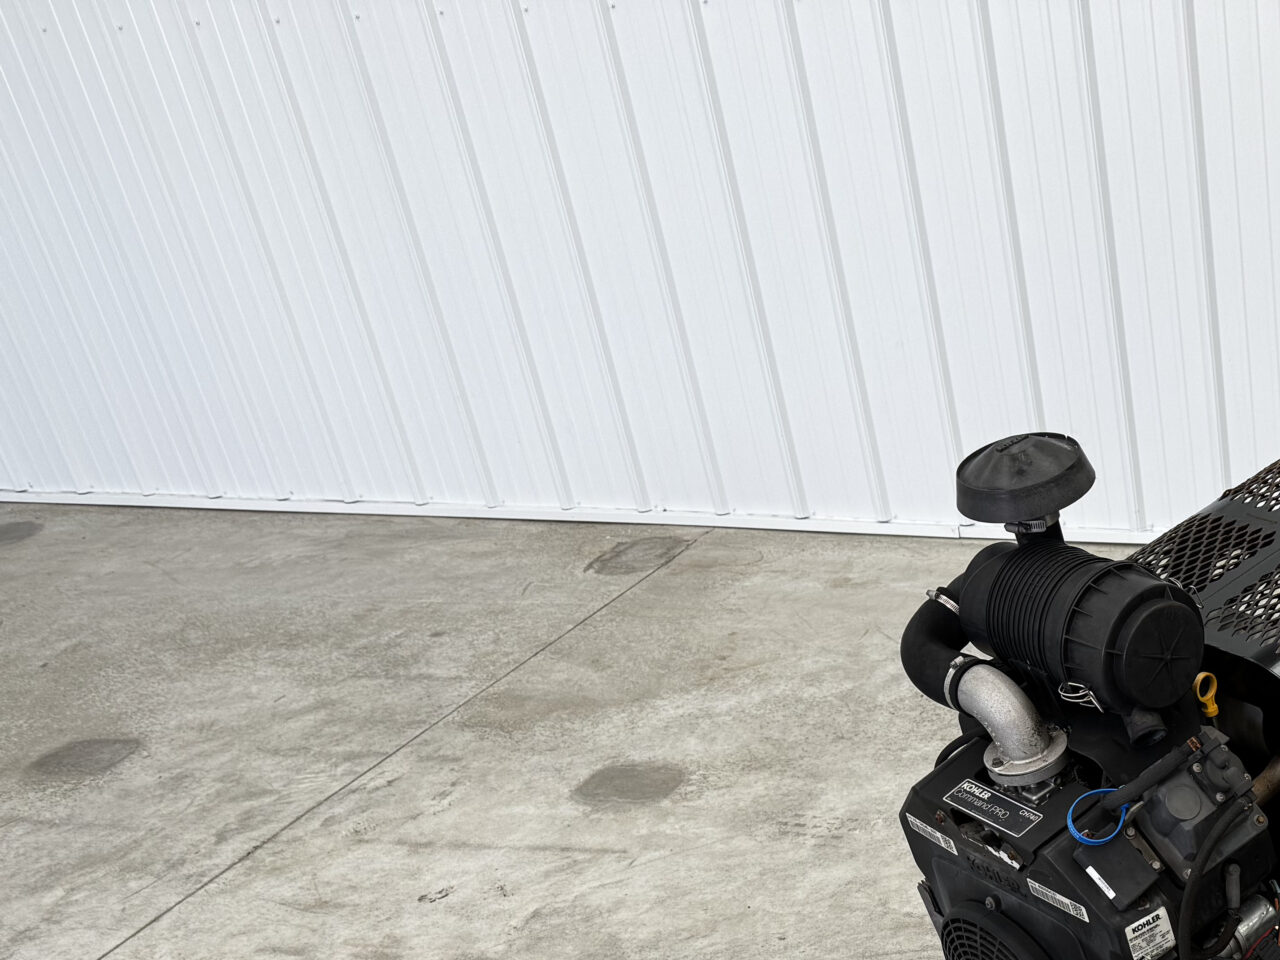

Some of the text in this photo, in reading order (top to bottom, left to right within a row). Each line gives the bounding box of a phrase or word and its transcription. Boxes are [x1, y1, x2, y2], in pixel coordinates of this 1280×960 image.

[961, 781, 992, 800] KOHLER
[954, 788, 1010, 819] Command PRO
[1131, 913, 1162, 934] KOHLER
